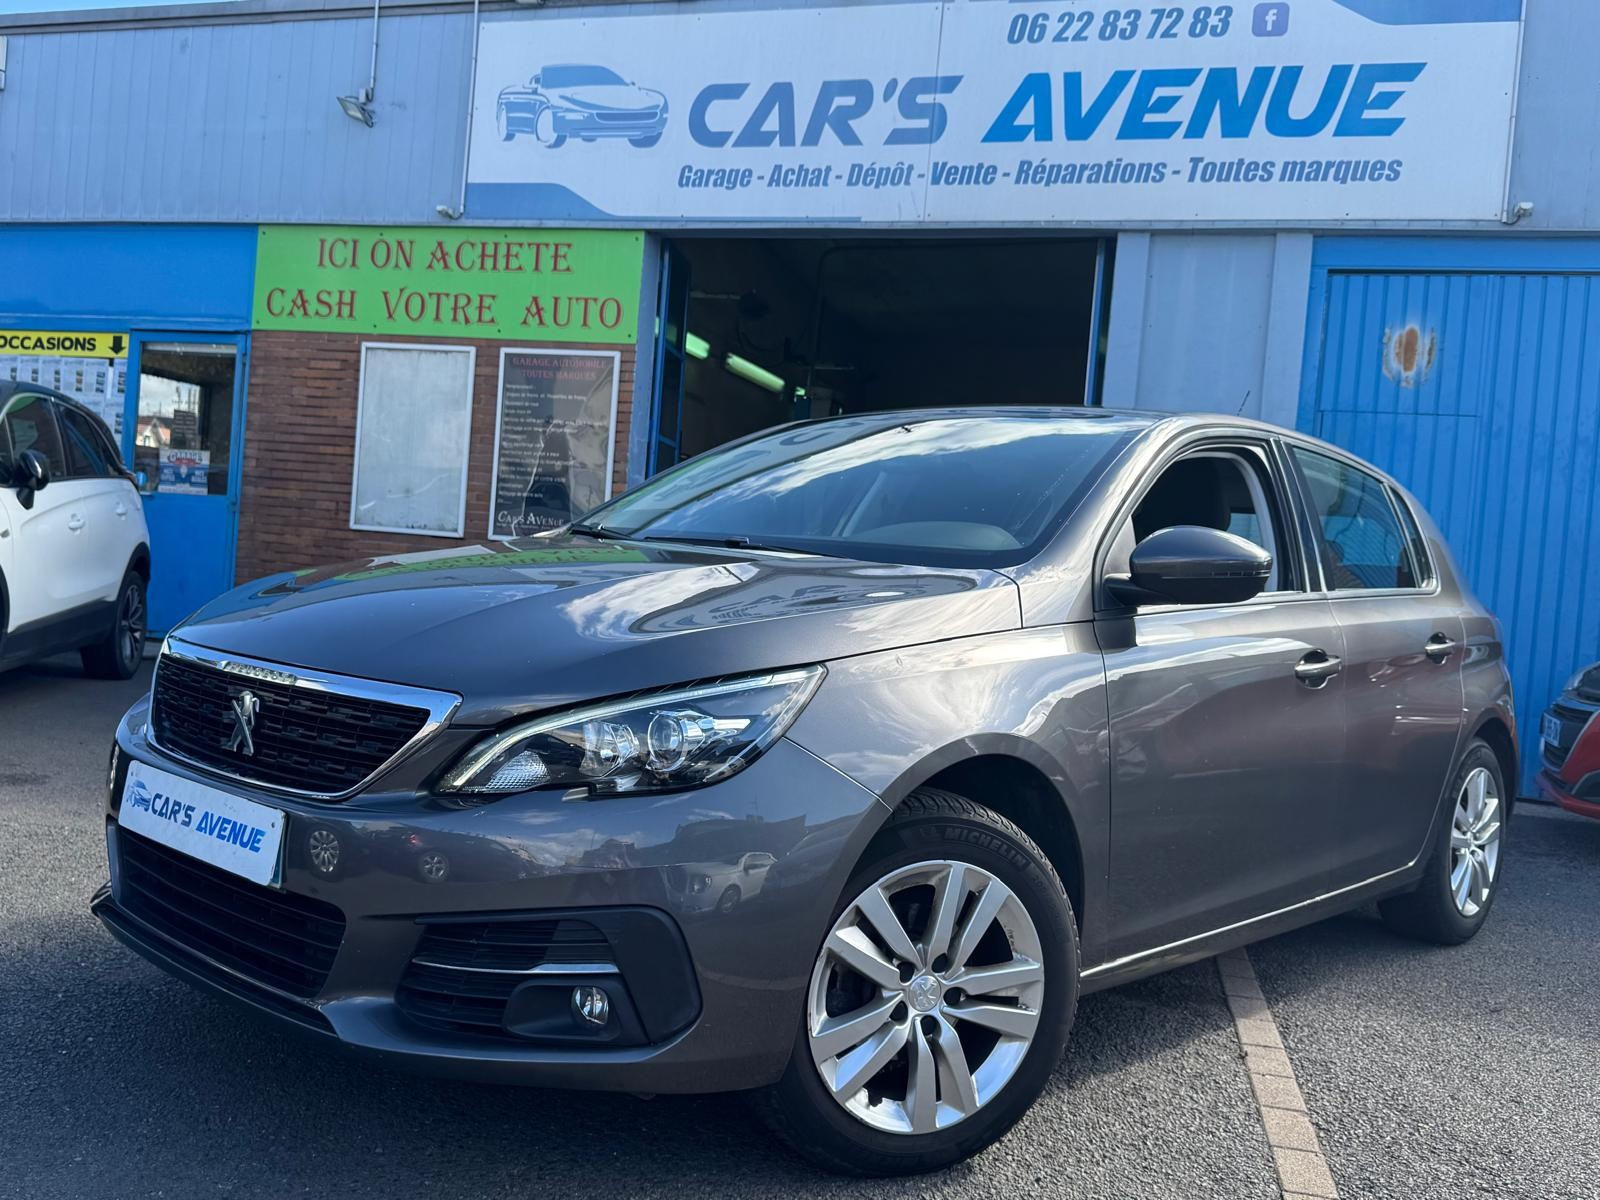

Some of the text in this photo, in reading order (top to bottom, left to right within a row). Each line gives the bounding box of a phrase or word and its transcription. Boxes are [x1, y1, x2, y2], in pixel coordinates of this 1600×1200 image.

[1007, 5, 1233, 45] 06 22 83 72 83
[688, 62, 1428, 148] CAR'S AVENUE
[678, 165, 753, 190] Garage
[767, 163, 832, 188] Achat
[846, 162, 914, 189] Dépôt
[930, 161, 997, 186] Vente
[1014, 157, 1167, 187] Réparations
[1187, 156, 1275, 183] Toutes
[1278, 159, 1403, 184] marques
[317, 237, 575, 274] ICI ON ACHETE
[266, 286, 623, 330] CASH VOTRE AUTO
[0, 335, 97, 351] OCCASIONS
[151, 792, 266, 853] CAR'S AVENUE
[944, 827, 1028, 869] MICHELIN
